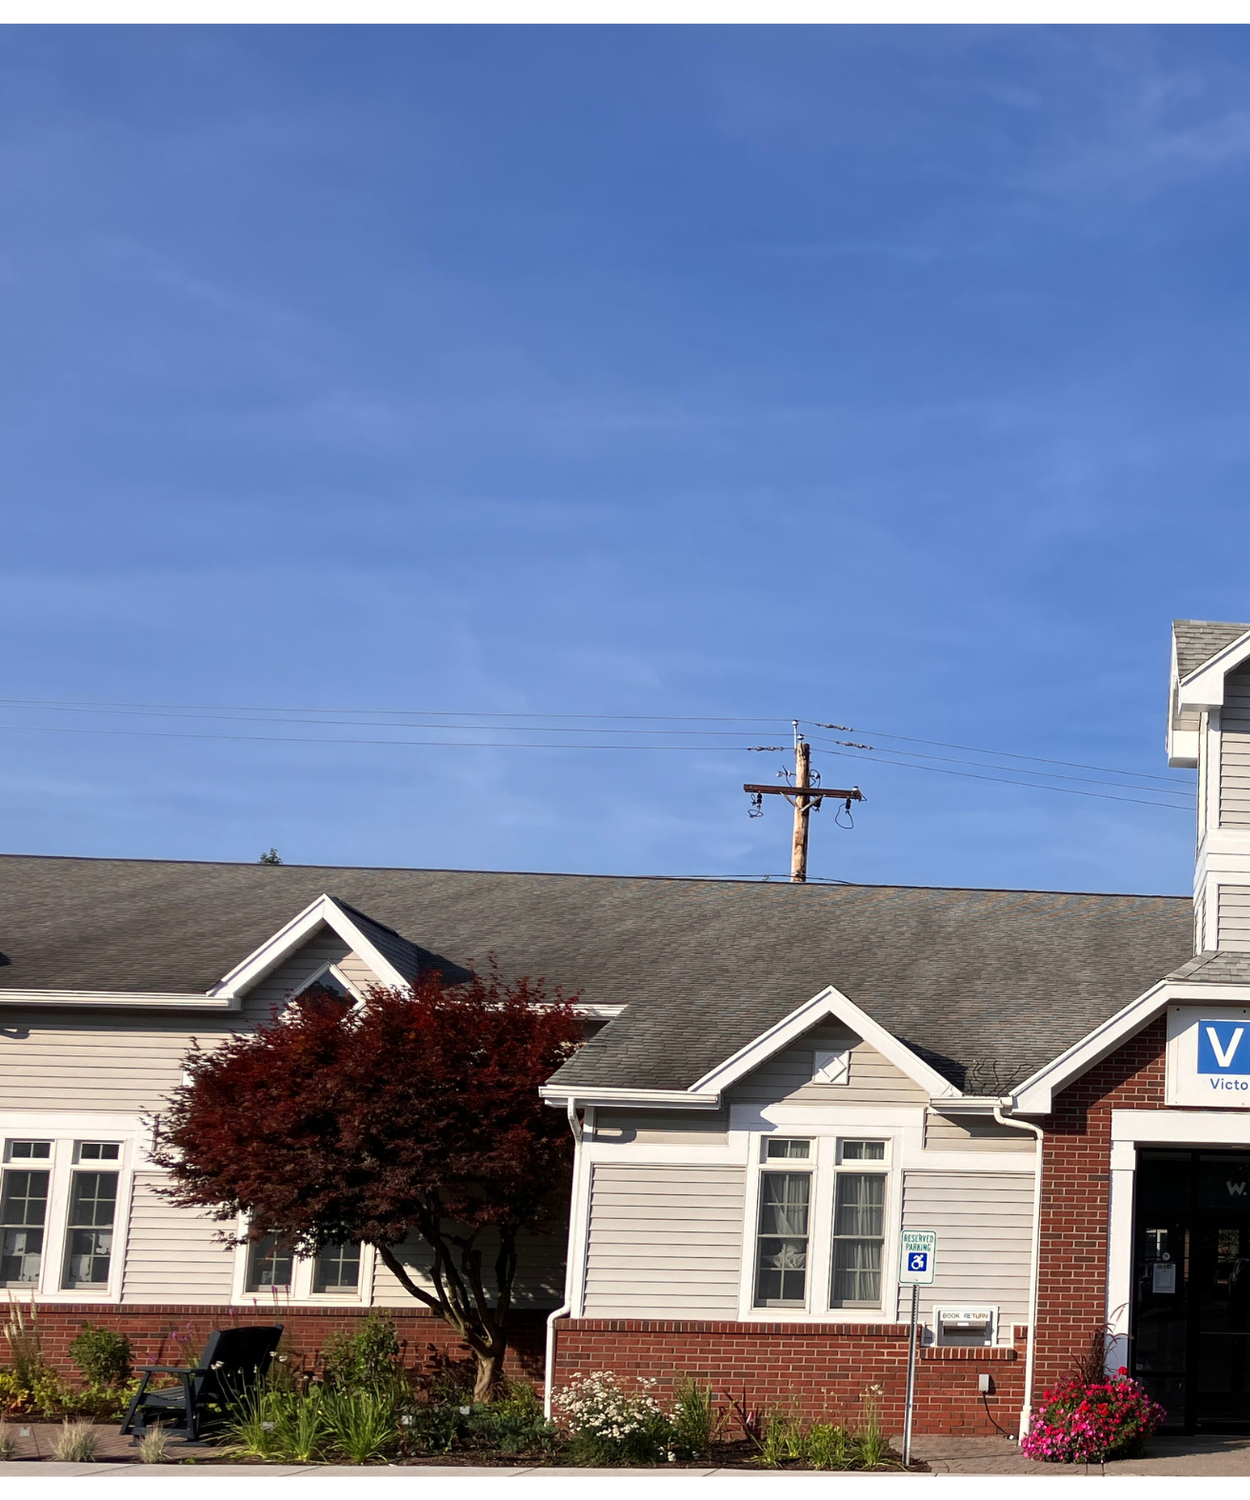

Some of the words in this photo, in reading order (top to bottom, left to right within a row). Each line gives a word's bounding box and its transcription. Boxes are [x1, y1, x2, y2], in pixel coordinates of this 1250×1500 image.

[1226, 1181, 1248, 1196] W.
[904, 1234, 933, 1243] RESERVED
[905, 1243, 931, 1252] PARKING
